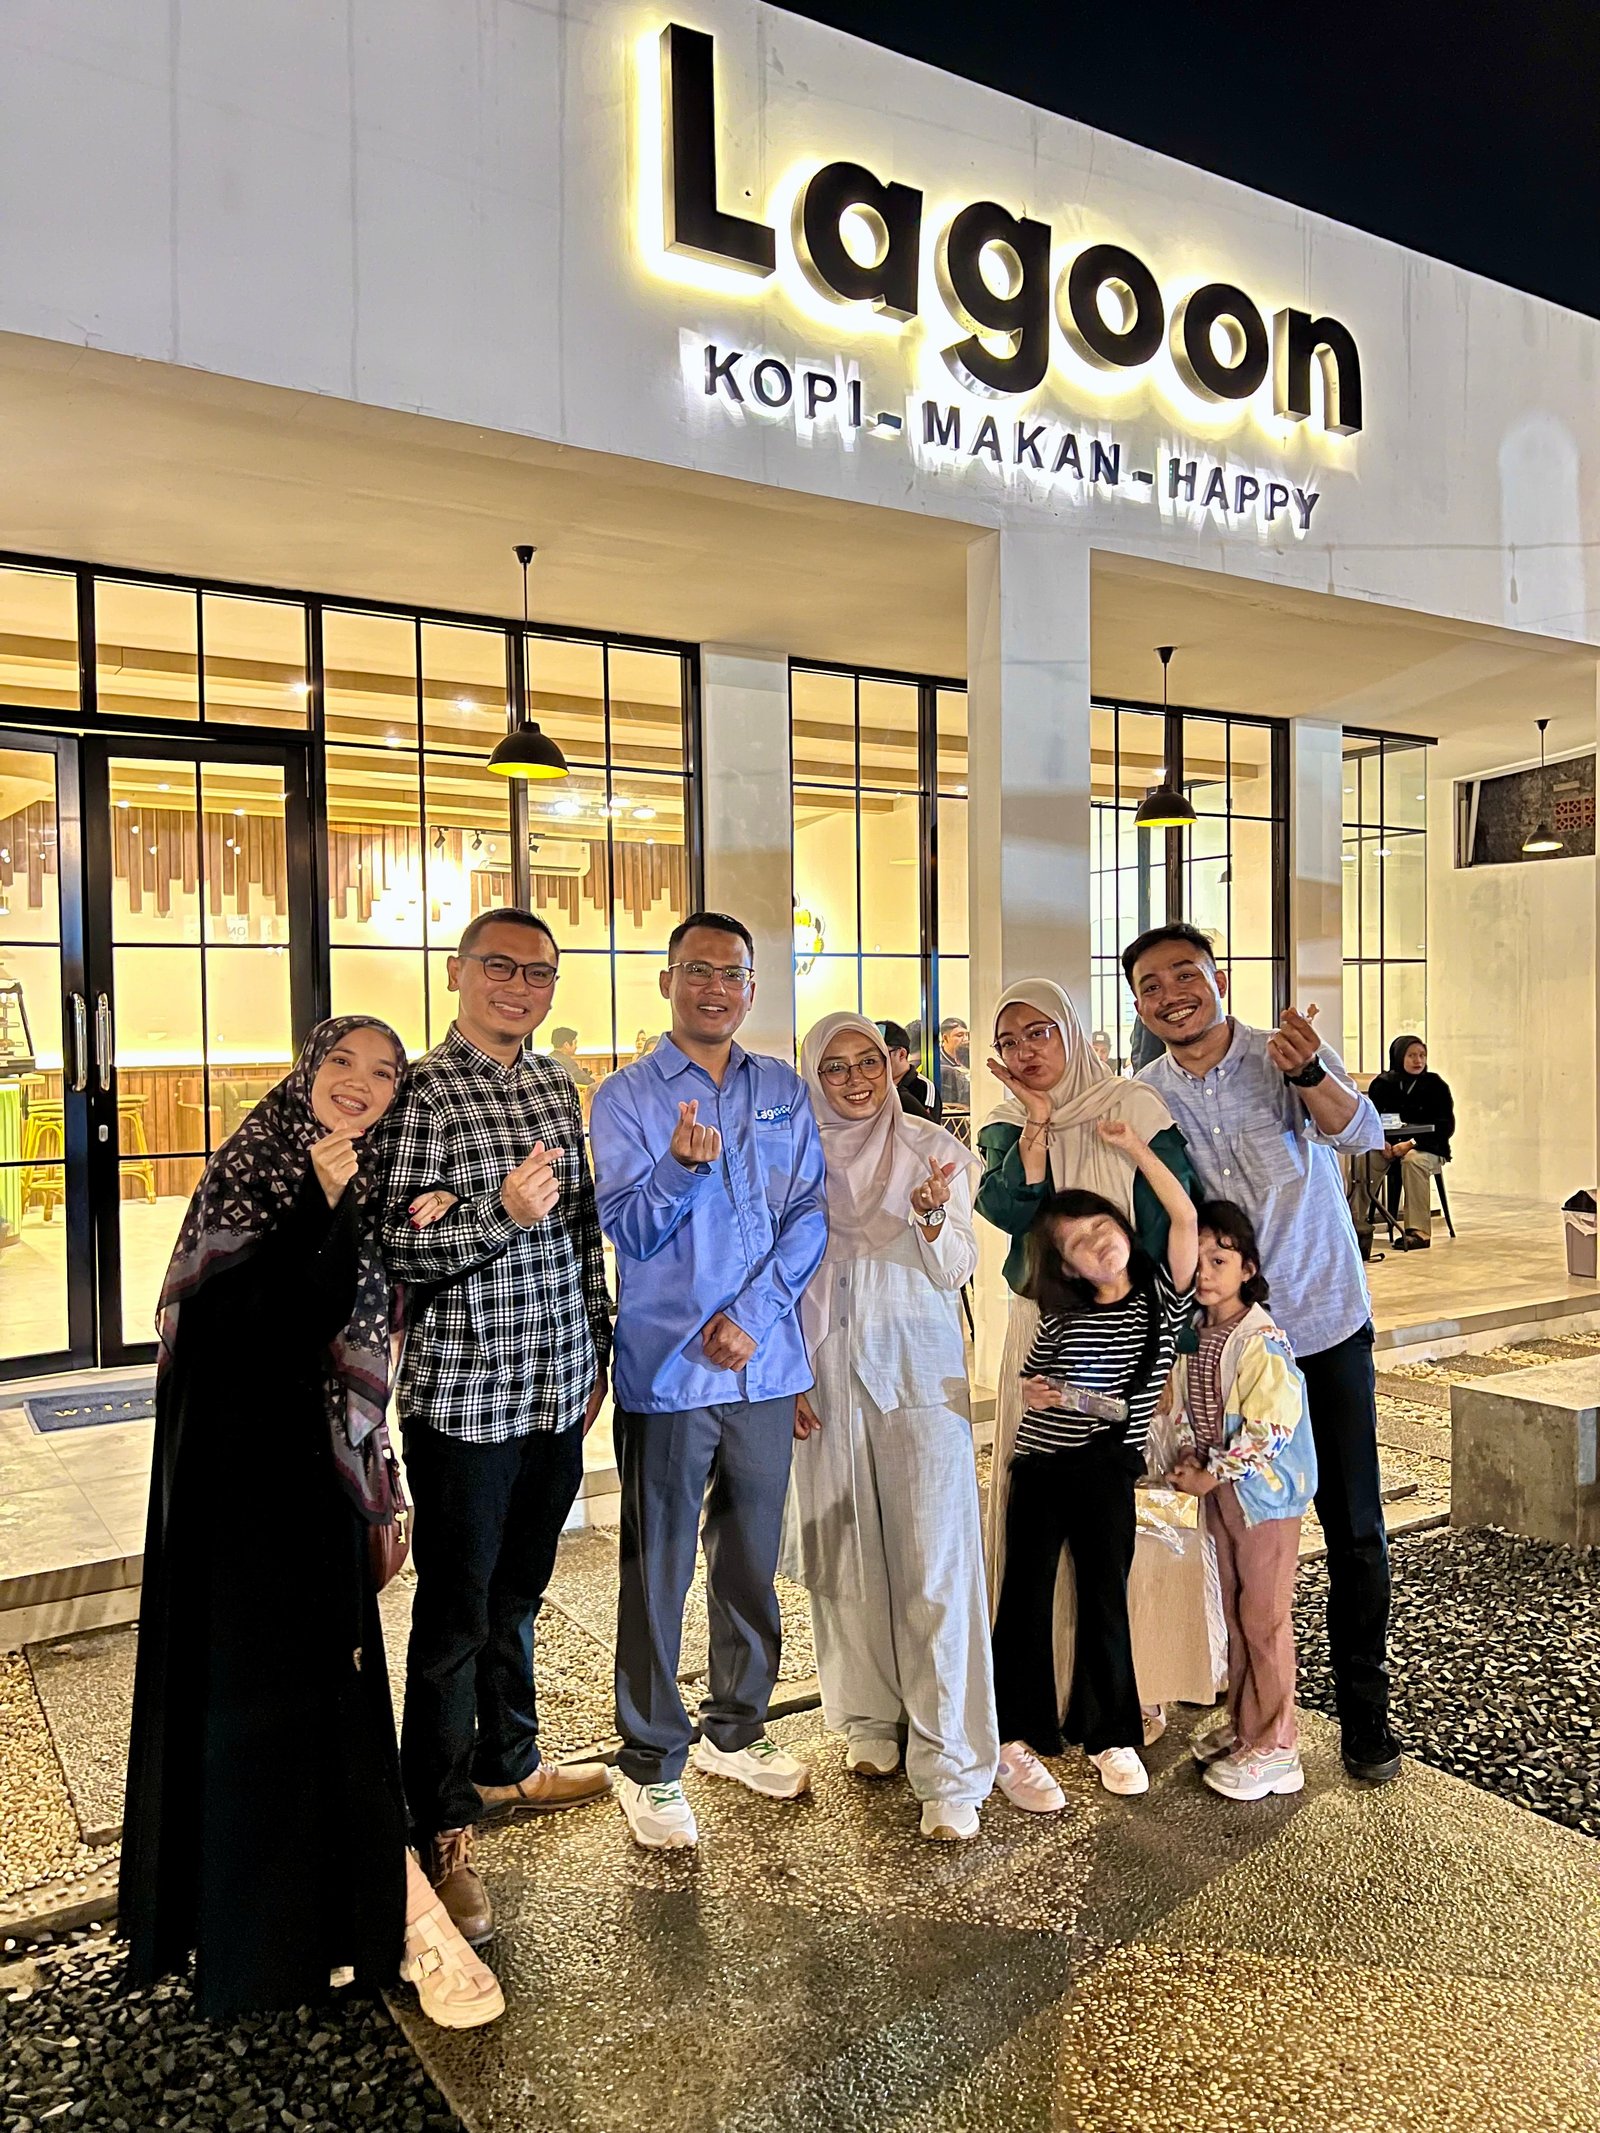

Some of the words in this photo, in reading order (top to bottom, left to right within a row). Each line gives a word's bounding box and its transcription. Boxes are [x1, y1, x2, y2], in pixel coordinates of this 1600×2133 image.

[660, 22, 1362, 436] Lagoon
[704, 345, 861, 428] KOPI
[922, 400, 1120, 486] MAKAN
[1168, 457, 1321, 530] HAPPY
